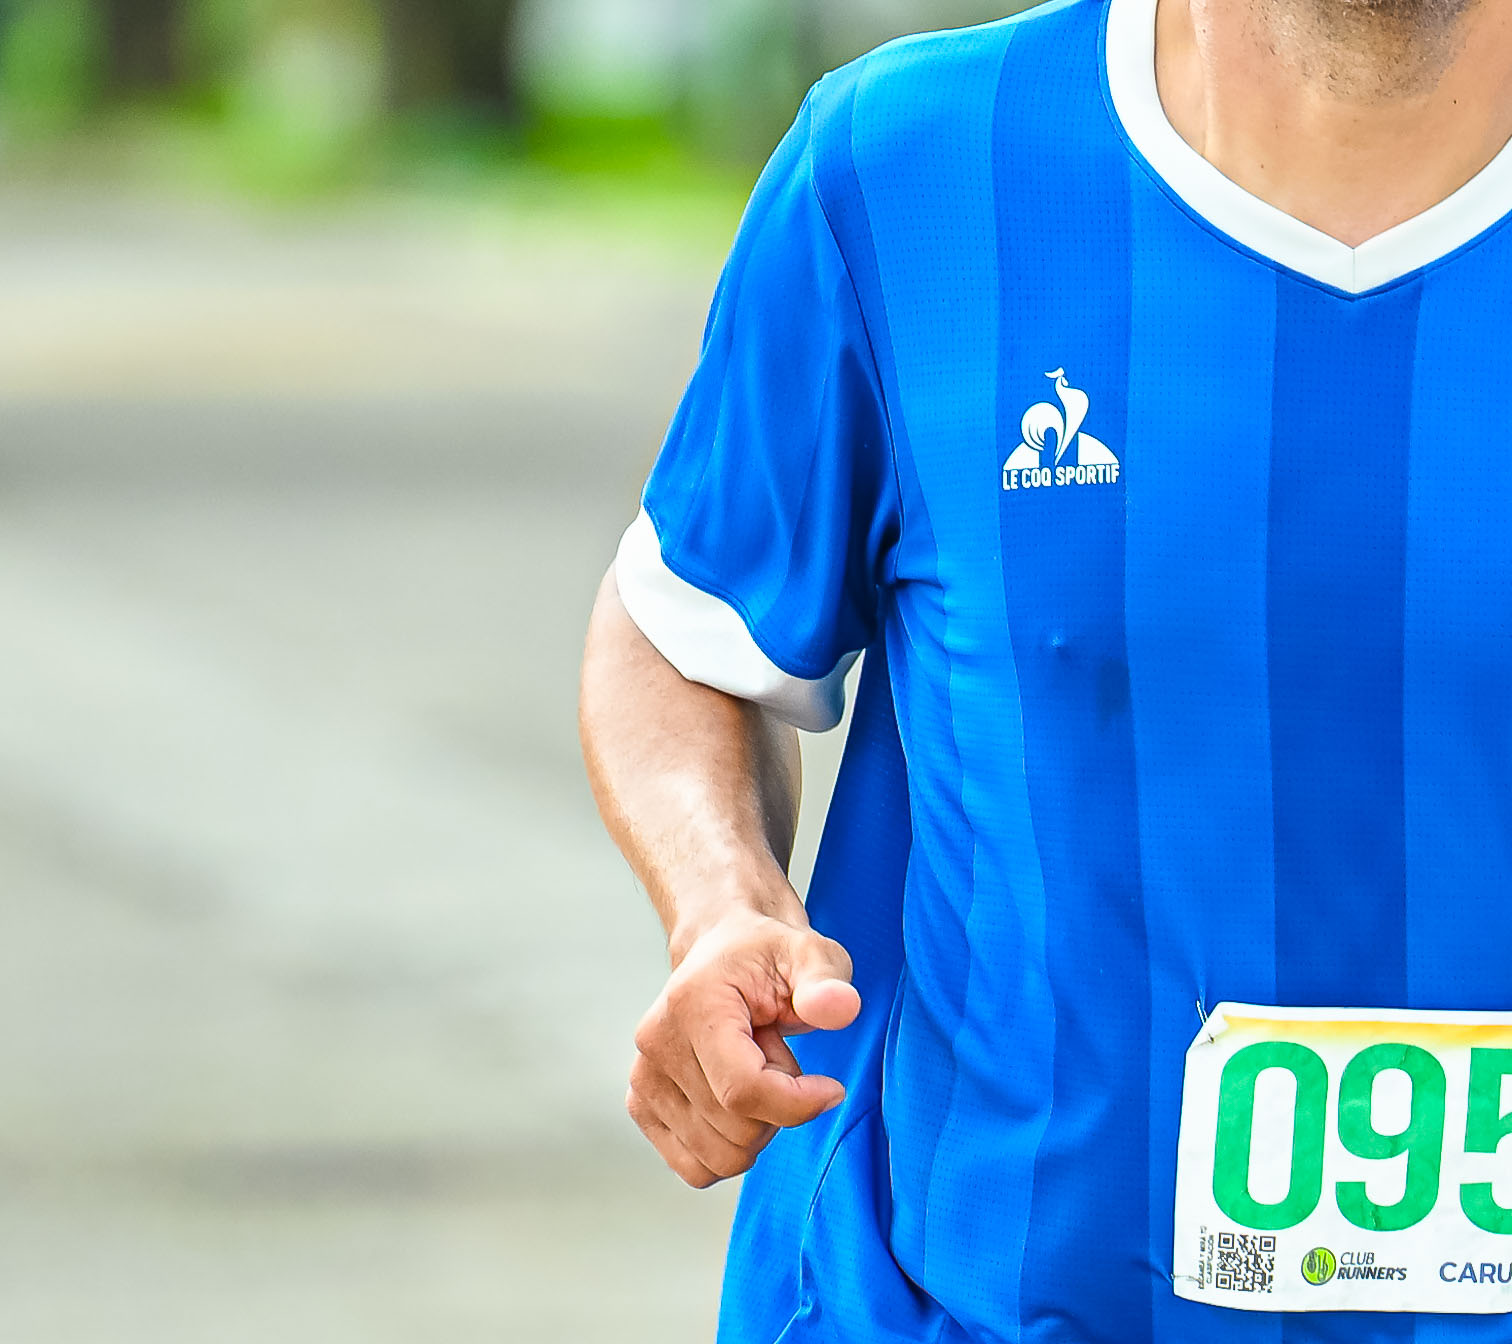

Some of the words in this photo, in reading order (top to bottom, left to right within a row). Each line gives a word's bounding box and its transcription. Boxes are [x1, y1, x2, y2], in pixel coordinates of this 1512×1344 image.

[1002, 469, 1019, 491] LE
[1021, 467, 1052, 489] COQ
[1054, 463, 1120, 487] SPORTIF
[1340, 1251, 1375, 1266] CLUB
[1336, 1266, 1408, 1281] RUNNER'S
